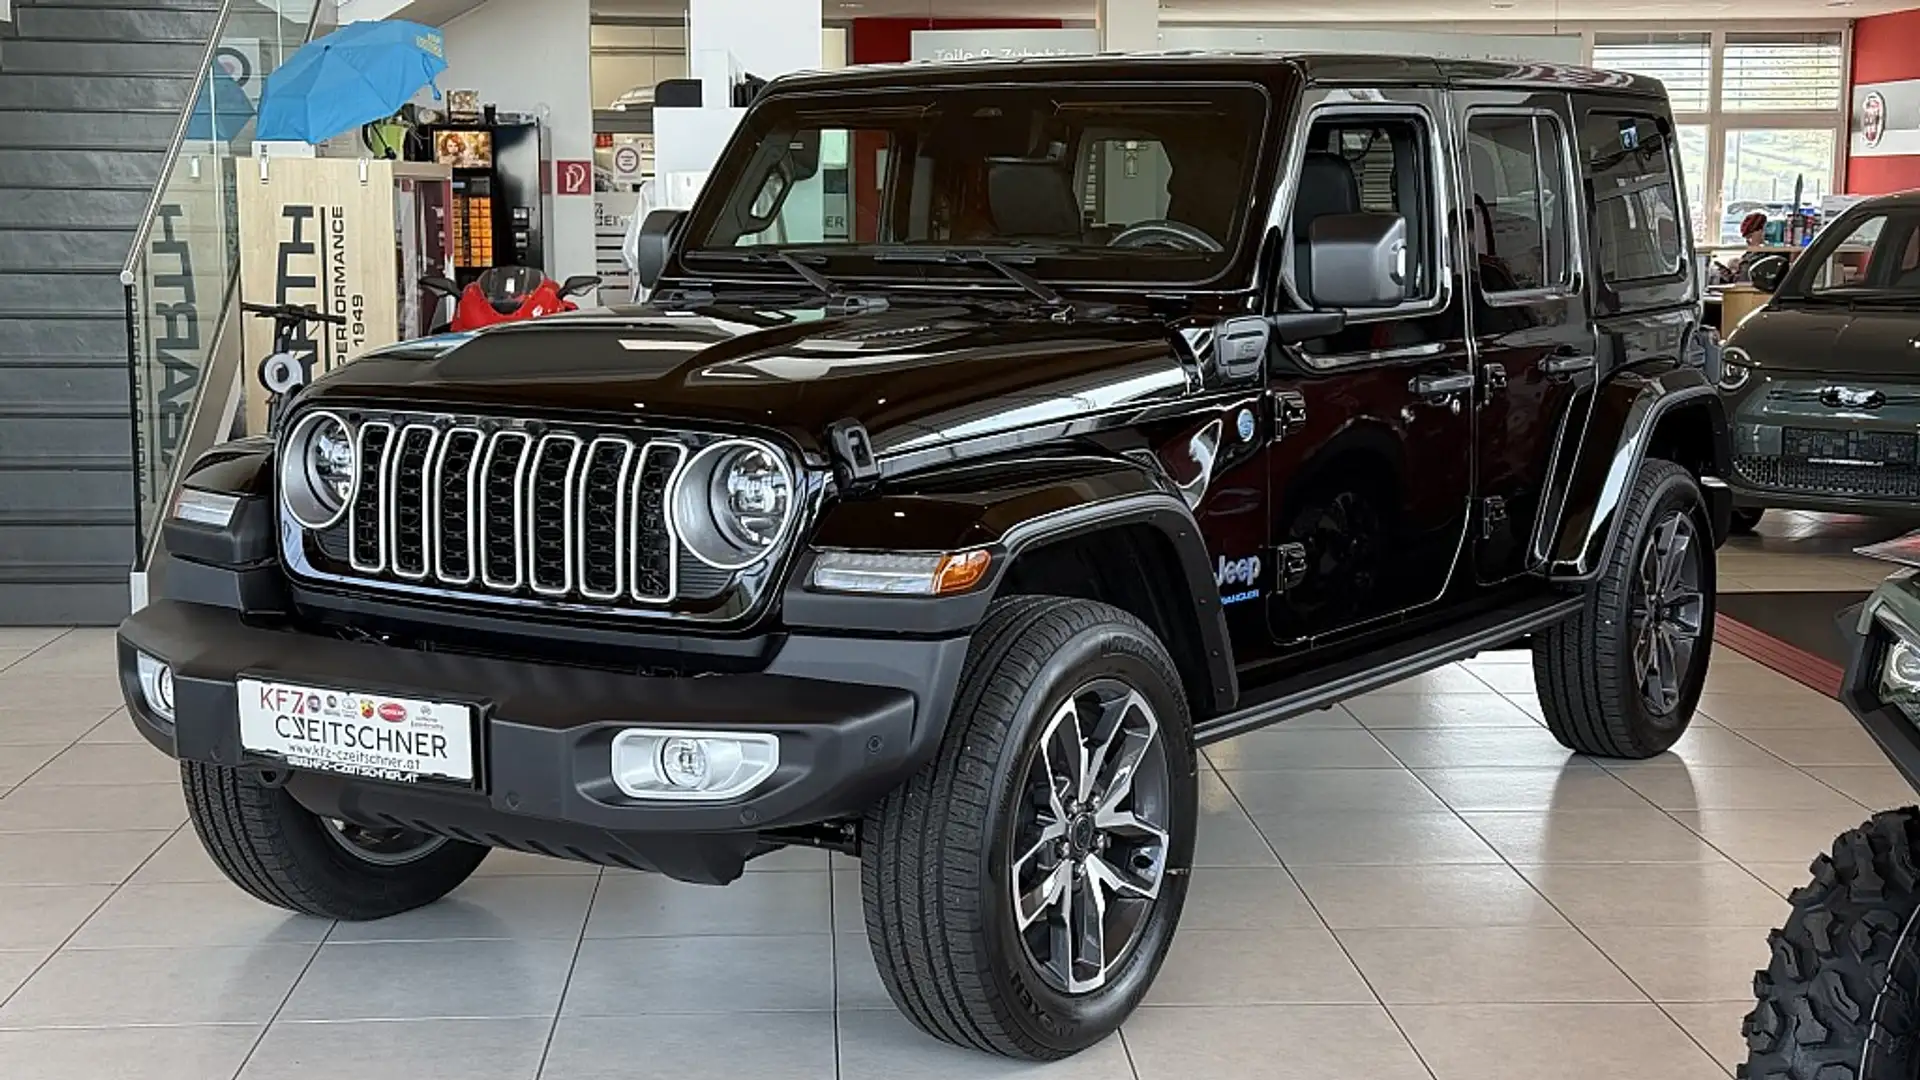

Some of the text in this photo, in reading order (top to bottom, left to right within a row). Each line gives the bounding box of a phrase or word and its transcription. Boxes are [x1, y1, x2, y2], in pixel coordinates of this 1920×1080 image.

[331, 206, 348, 367] PERORMANCE
[352, 294, 365, 348] 1949
[1212, 554, 1261, 588] Jeep
[260, 686, 305, 715] KFZ
[274, 714, 449, 759] CZEITSCHNER
